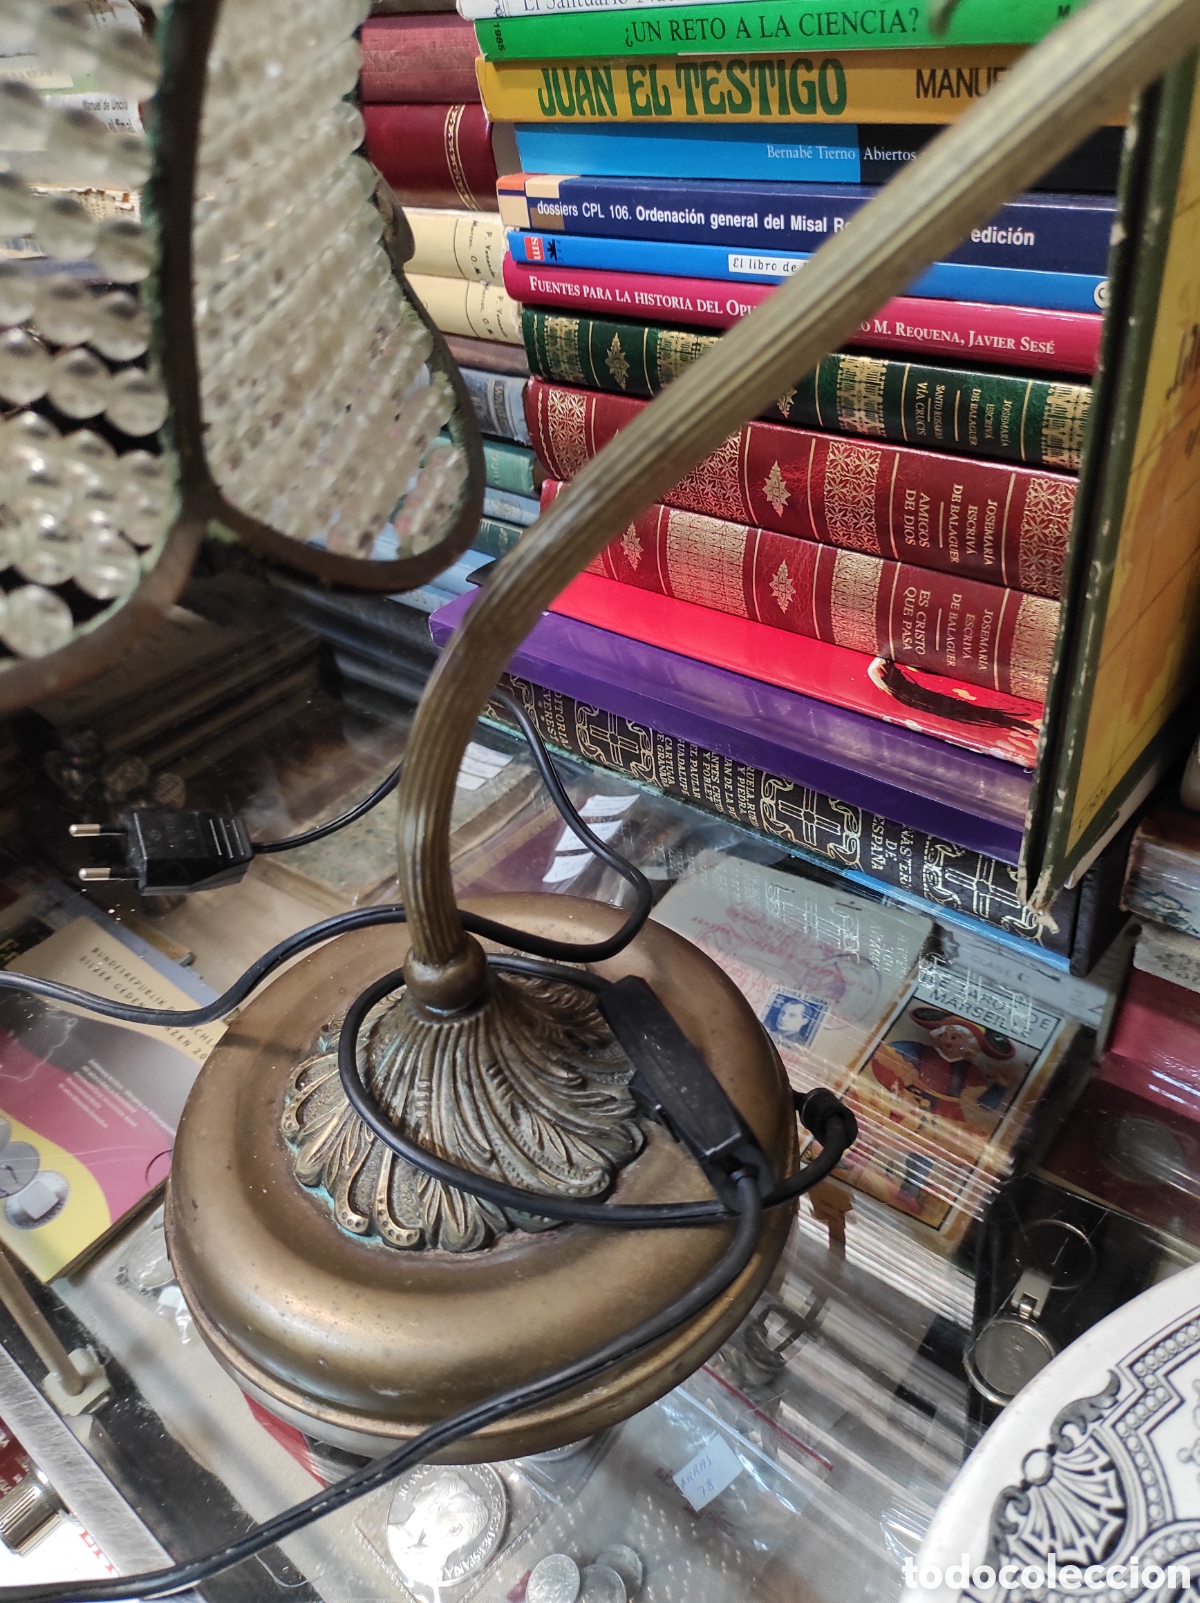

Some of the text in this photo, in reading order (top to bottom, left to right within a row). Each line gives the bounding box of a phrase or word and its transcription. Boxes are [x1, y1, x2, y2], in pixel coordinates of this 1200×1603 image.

[493, 21, 505, 51] 1985
[625, 8, 920, 47] ¿UN RETO A LA CIENCIA?
[537, 57, 848, 118] JUAN EL TESTIGO
[766, 144, 857, 161] Bernabé Tierno
[863, 145, 917, 162] Abiertos
[537, 200, 579, 217] dossiers
[582, 202, 605, 219] CPL
[609, 204, 632, 221] 106.
[636, 205, 705, 225] Ordenación
[710, 212, 758, 230] general
[764, 213, 785, 230] del
[790, 214, 828, 233] Misal
[970, 226, 1035, 247] edición
[531, 237, 541, 260] sm
[733, 258, 743, 269] El
[749, 259, 777, 272] libro
[783, 261, 797, 273] de
[529, 275, 757, 317] FUENTES PARA LA HISTORIA DEL OPU
[874, 319, 892, 335] M.
[895, 321, 965, 346] REQUENA,
[968, 330, 1016, 351] JAVIER
[1020, 336, 1055, 355] SESÉ
[915, 381, 929, 436] VÍA CRUCIS
[934, 384, 946, 410] SANTO
[968, 388, 982, 446] DE BALAGUER
[984, 403, 995, 439] ESCRIVÁ
[1001, 399, 1013, 447] JOSEMARÍA
[903, 488, 917, 546] DE DIOS
[918, 492, 931, 548] AMIGOS
[948, 483, 964, 563] DE BALAGUER
[965, 504, 979, 555] ESCRIVÁ
[983, 498, 998, 566] JOSEMARÍA
[902, 586, 917, 650] QUE PASA
[914, 589, 931, 655] ES CRISTO
[946, 593, 962, 667] DE BALAGUER
[962, 613, 976, 660] ESCRIVÁ
[978, 609, 994, 671] JOSEMARÍA
[554, 691, 572, 750] DITORIAL
[664, 737, 676, 785] CARTUJA
[690, 759, 702, 799] PAULAR
[702, 761, 713, 803] POBLET
[724, 777, 733, 790] DE
[724, 791, 734, 804] LA
[737, 776, 747, 815] PIEDRA
[870, 813, 887, 870] ESPAÑA
